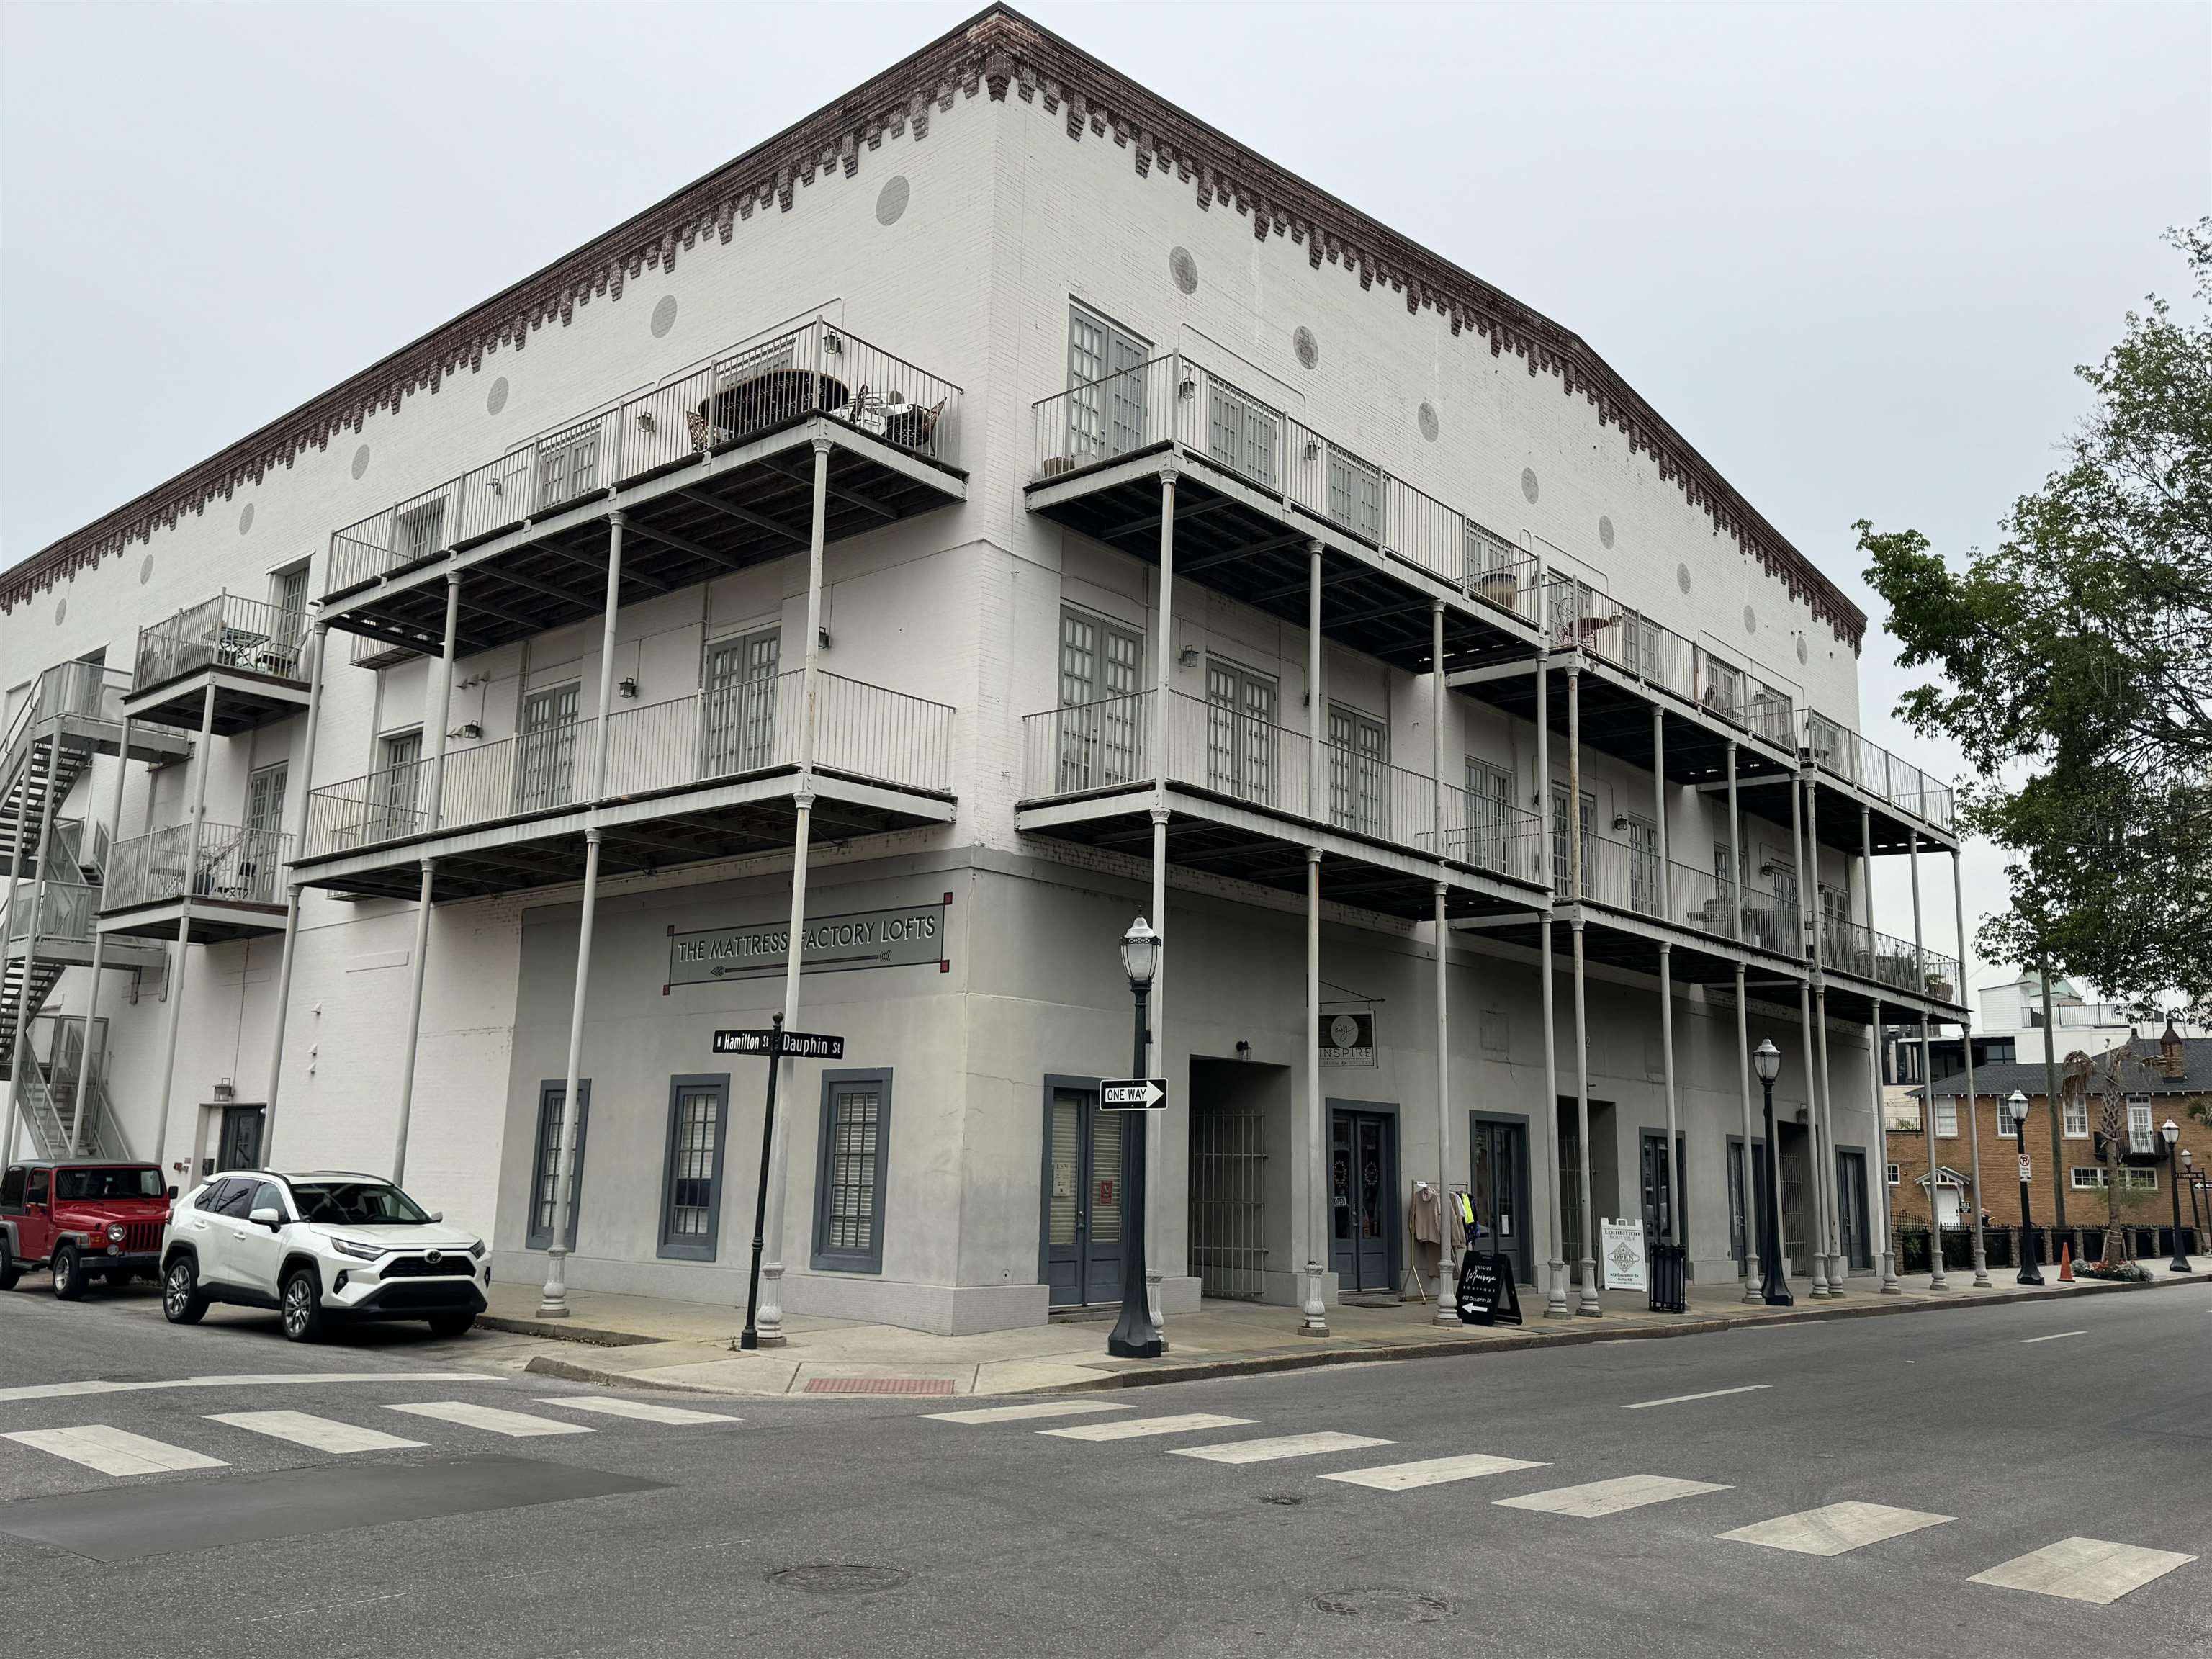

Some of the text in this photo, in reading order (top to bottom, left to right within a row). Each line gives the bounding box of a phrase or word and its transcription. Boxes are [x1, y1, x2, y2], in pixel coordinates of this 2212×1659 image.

[678, 940, 705, 962] THE
[709, 931, 788, 959] MATTRESS
[881, 915, 935, 943] LOFTS
[724, 1033, 759, 1050] Hamilton
[762, 1035, 768, 1047] St
[783, 1034, 841, 1056] Dauphin St
[1319, 1048, 1372, 1058] INSPIRE
[1107, 1089, 1147, 1100] ONE WAY
